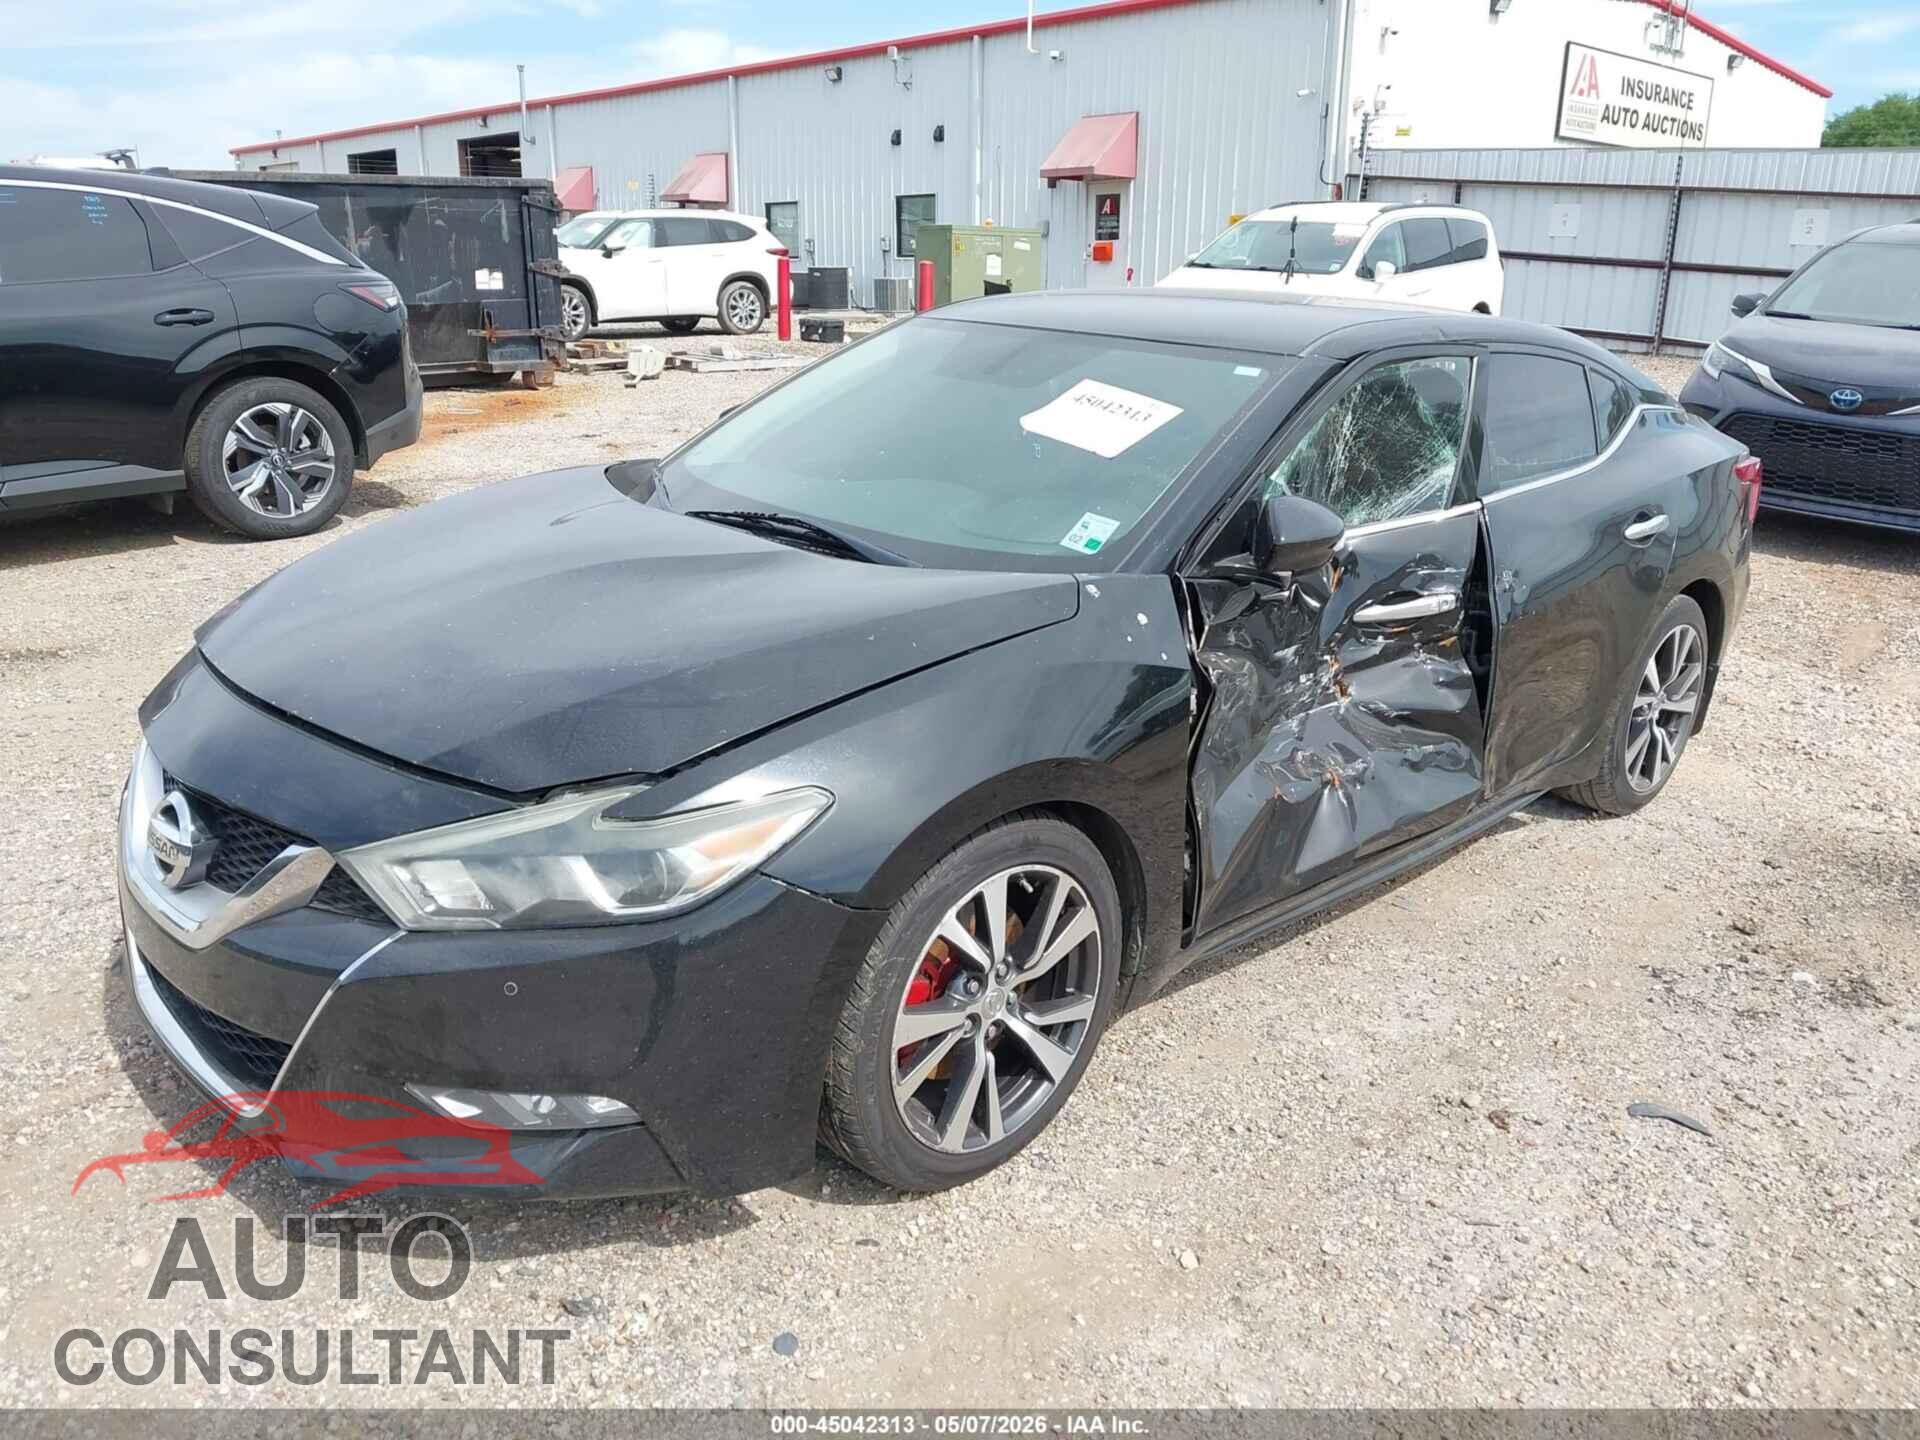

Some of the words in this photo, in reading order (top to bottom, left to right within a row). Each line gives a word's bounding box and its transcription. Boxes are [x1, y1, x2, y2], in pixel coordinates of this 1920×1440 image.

[1620, 75, 1695, 111] INSURANCE
[1600, 103, 1640, 130] AUTO
[1641, 110, 1704, 142] AUCTIONS
